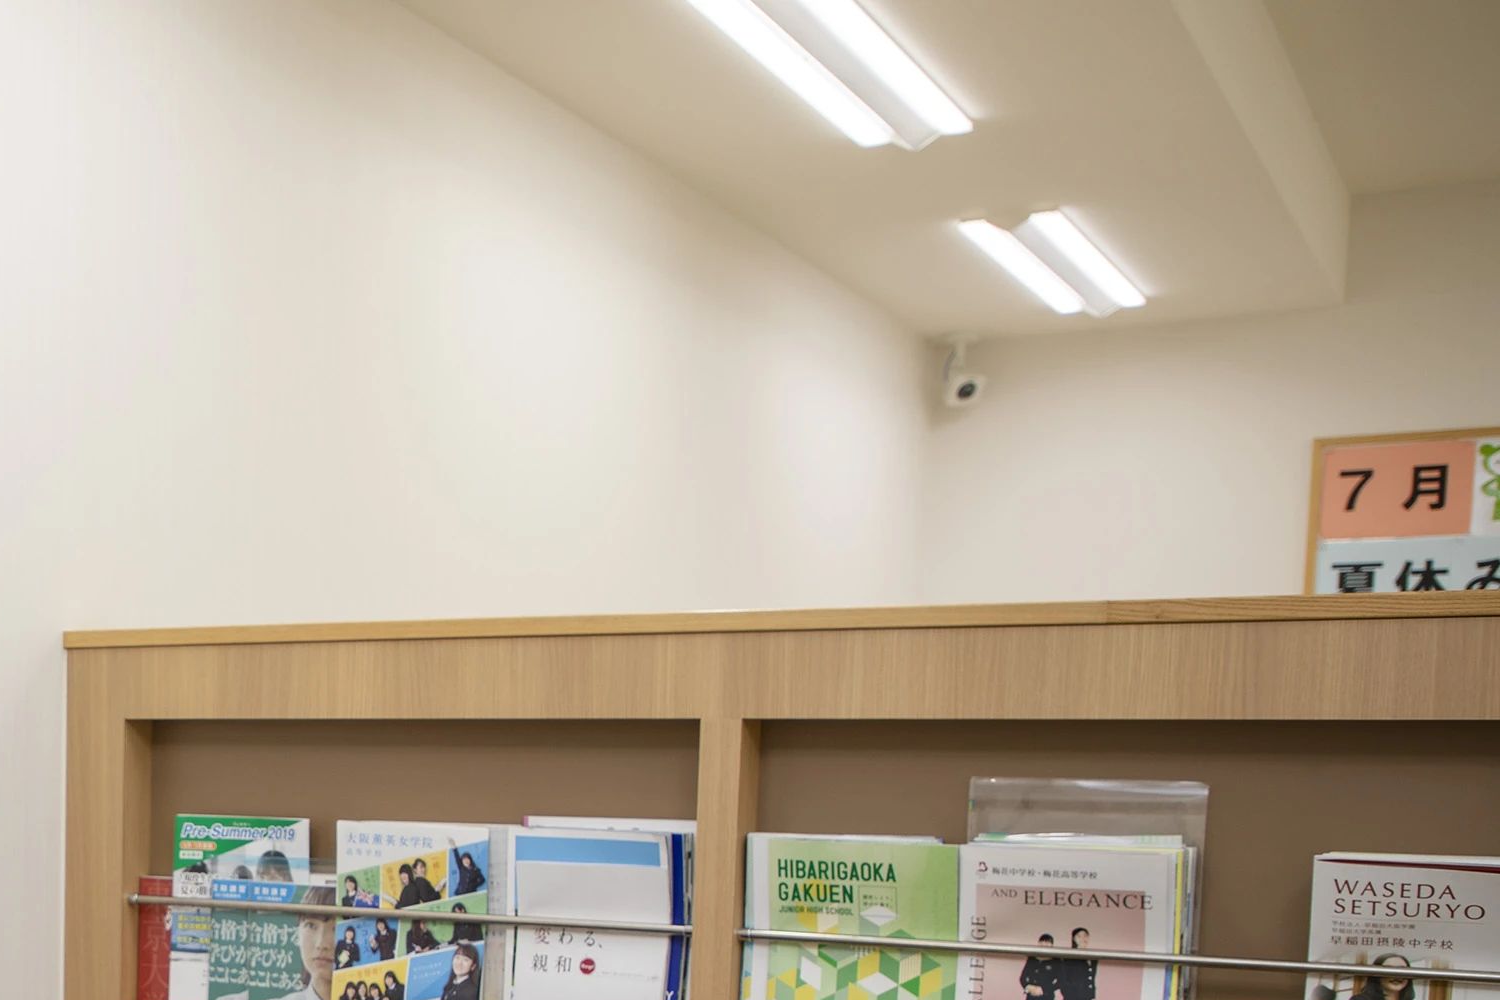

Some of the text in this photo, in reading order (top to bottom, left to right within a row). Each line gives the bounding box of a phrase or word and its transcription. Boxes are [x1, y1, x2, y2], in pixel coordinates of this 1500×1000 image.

[181, 822, 296, 841] Pre-Summer 2019
[778, 859, 896, 883] HIBARIGAOKA
[778, 882, 854, 904] GAKUEN
[991, 888, 1154, 911] AND ELEGANCE
[1334, 878, 1456, 900] WASEDA
[779, 906, 854, 916] JUNIOR HIGH SCHOOL
[1334, 898, 1486, 921] SETSURYO
[1331, 936, 1453, 951] 早稲田摂陵中学校
[250, 944, 292, 968] 学びが
[533, 953, 572, 974] 親和
